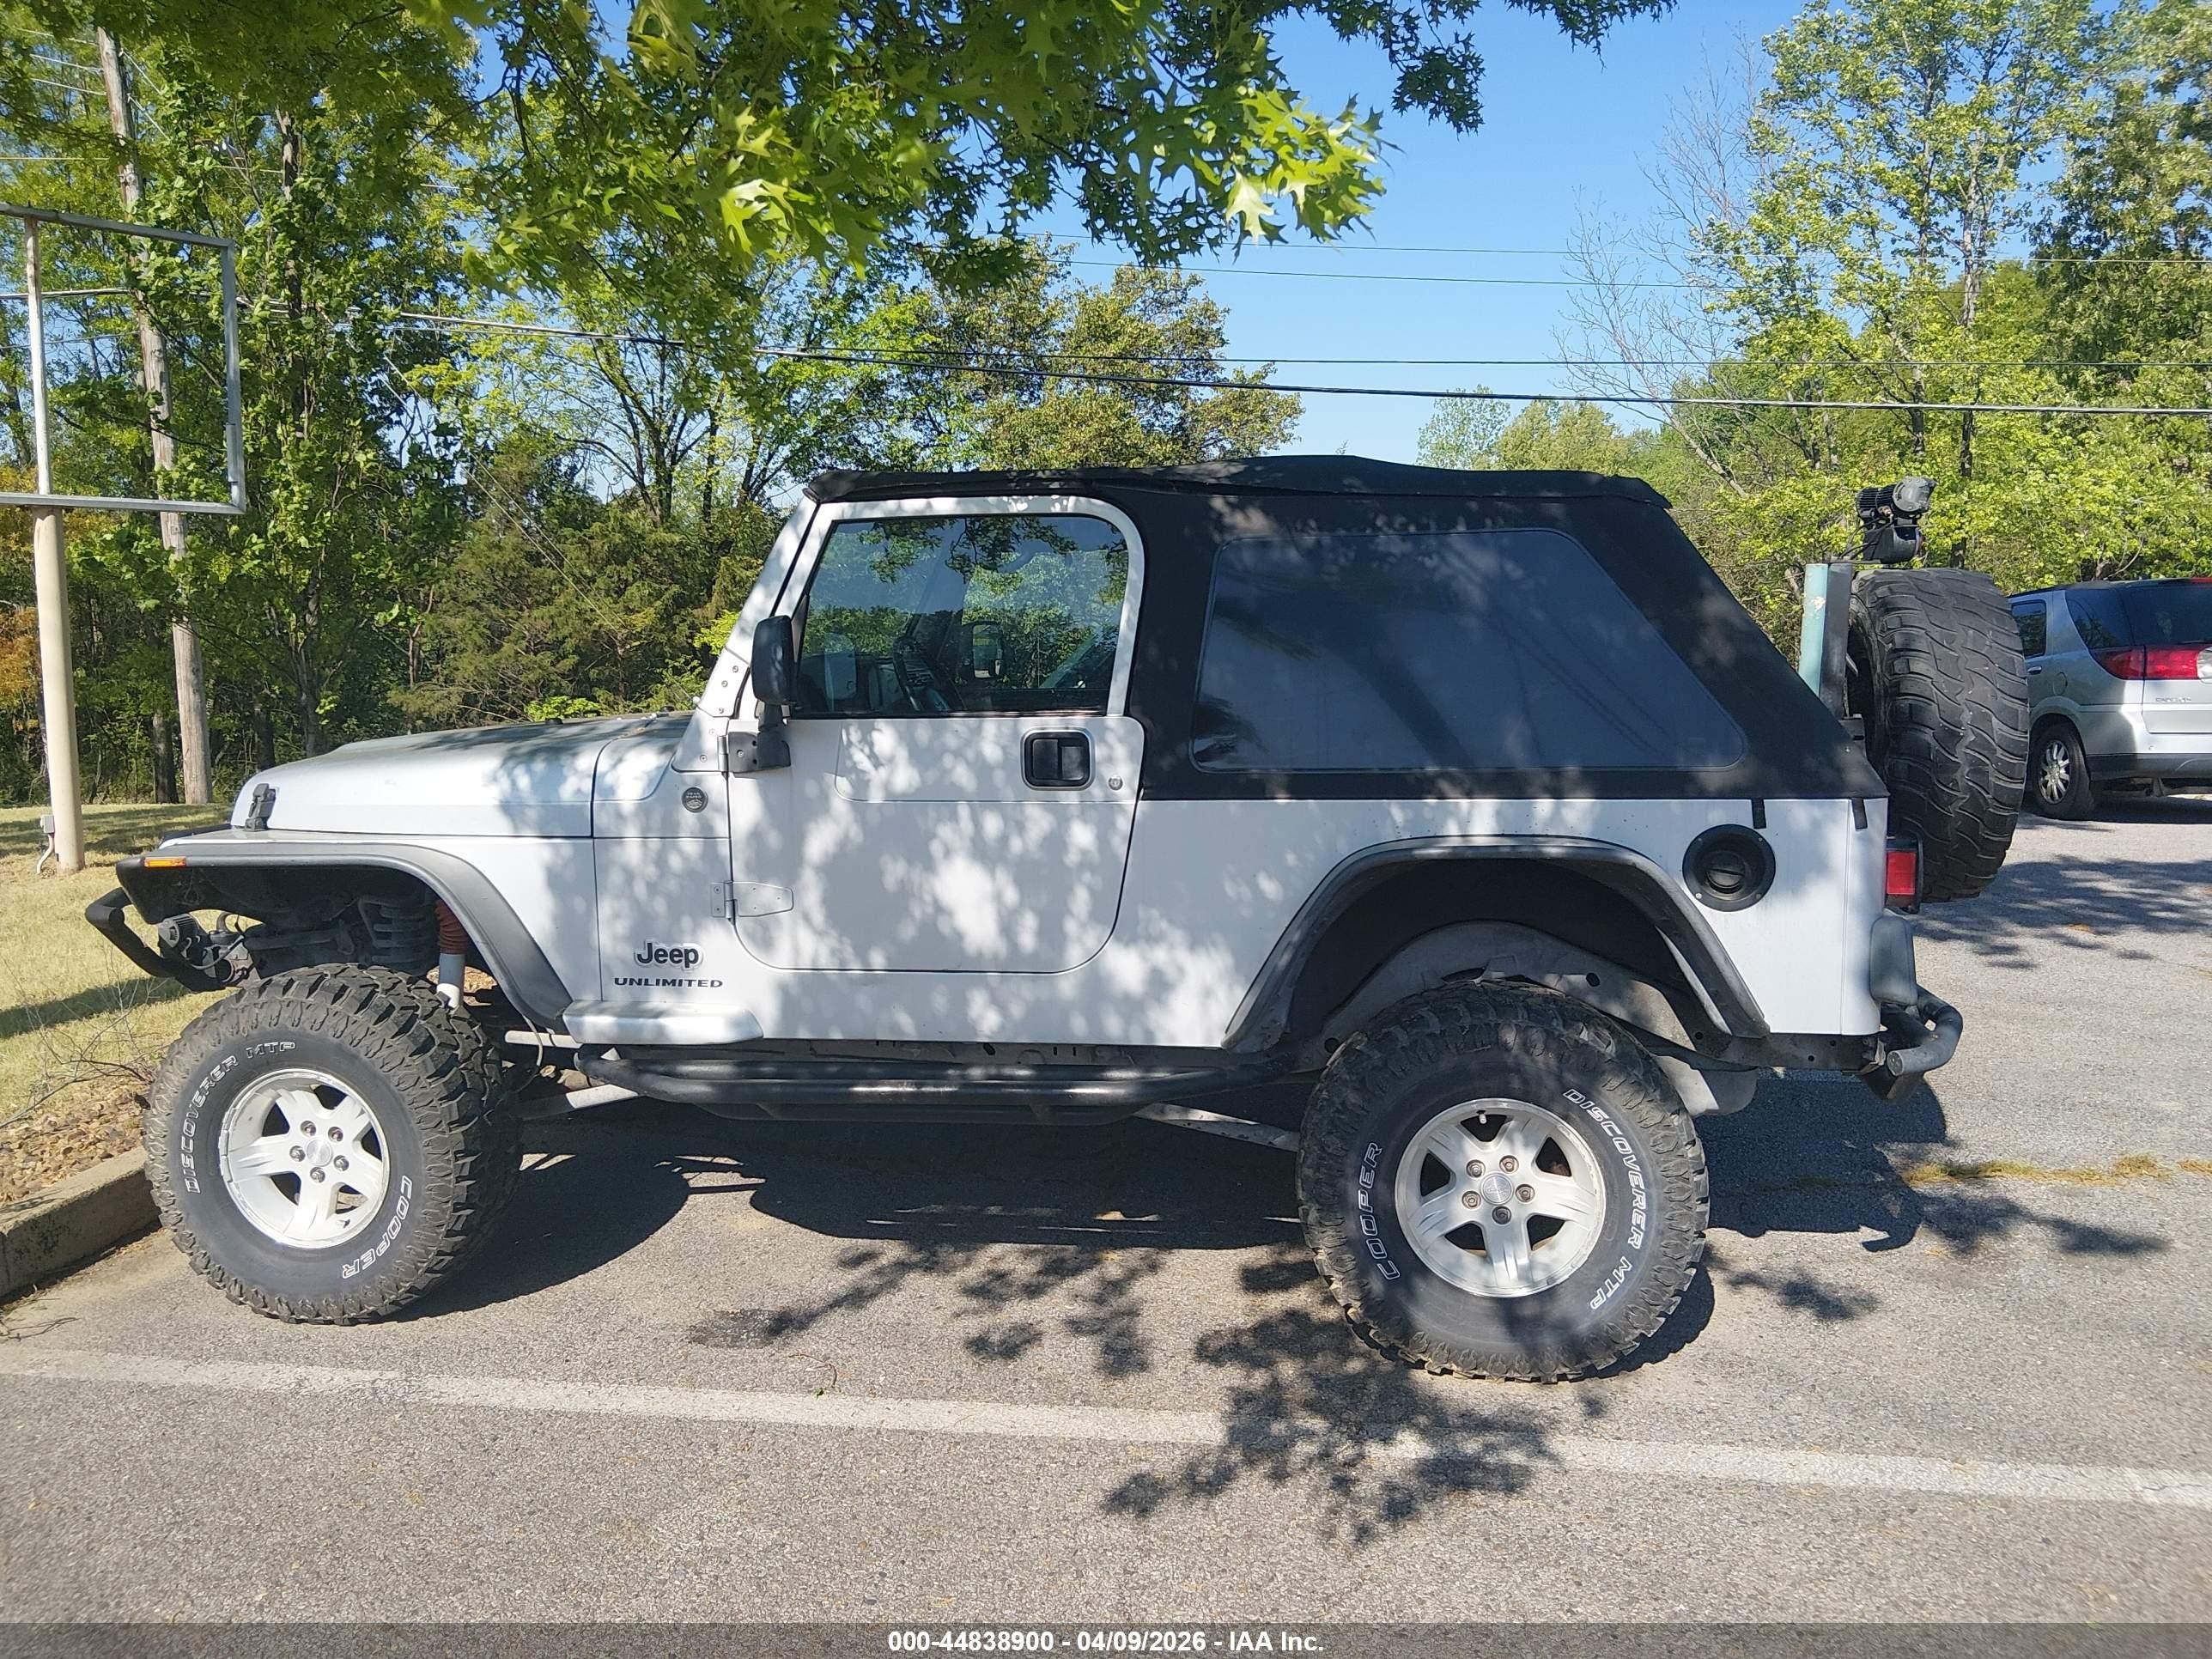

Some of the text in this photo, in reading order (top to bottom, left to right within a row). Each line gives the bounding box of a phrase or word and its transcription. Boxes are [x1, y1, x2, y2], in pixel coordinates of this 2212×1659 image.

[614, 977, 724, 988] UNLIMITED
[636, 942, 700, 969] Jeep
[180, 1041, 295, 1194] DISCOVERER MTP
[341, 1175, 413, 1279] COOPER
[1357, 1142, 1401, 1281] COOPER
[1563, 1088, 1649, 1311] DISCOVERER MTP
